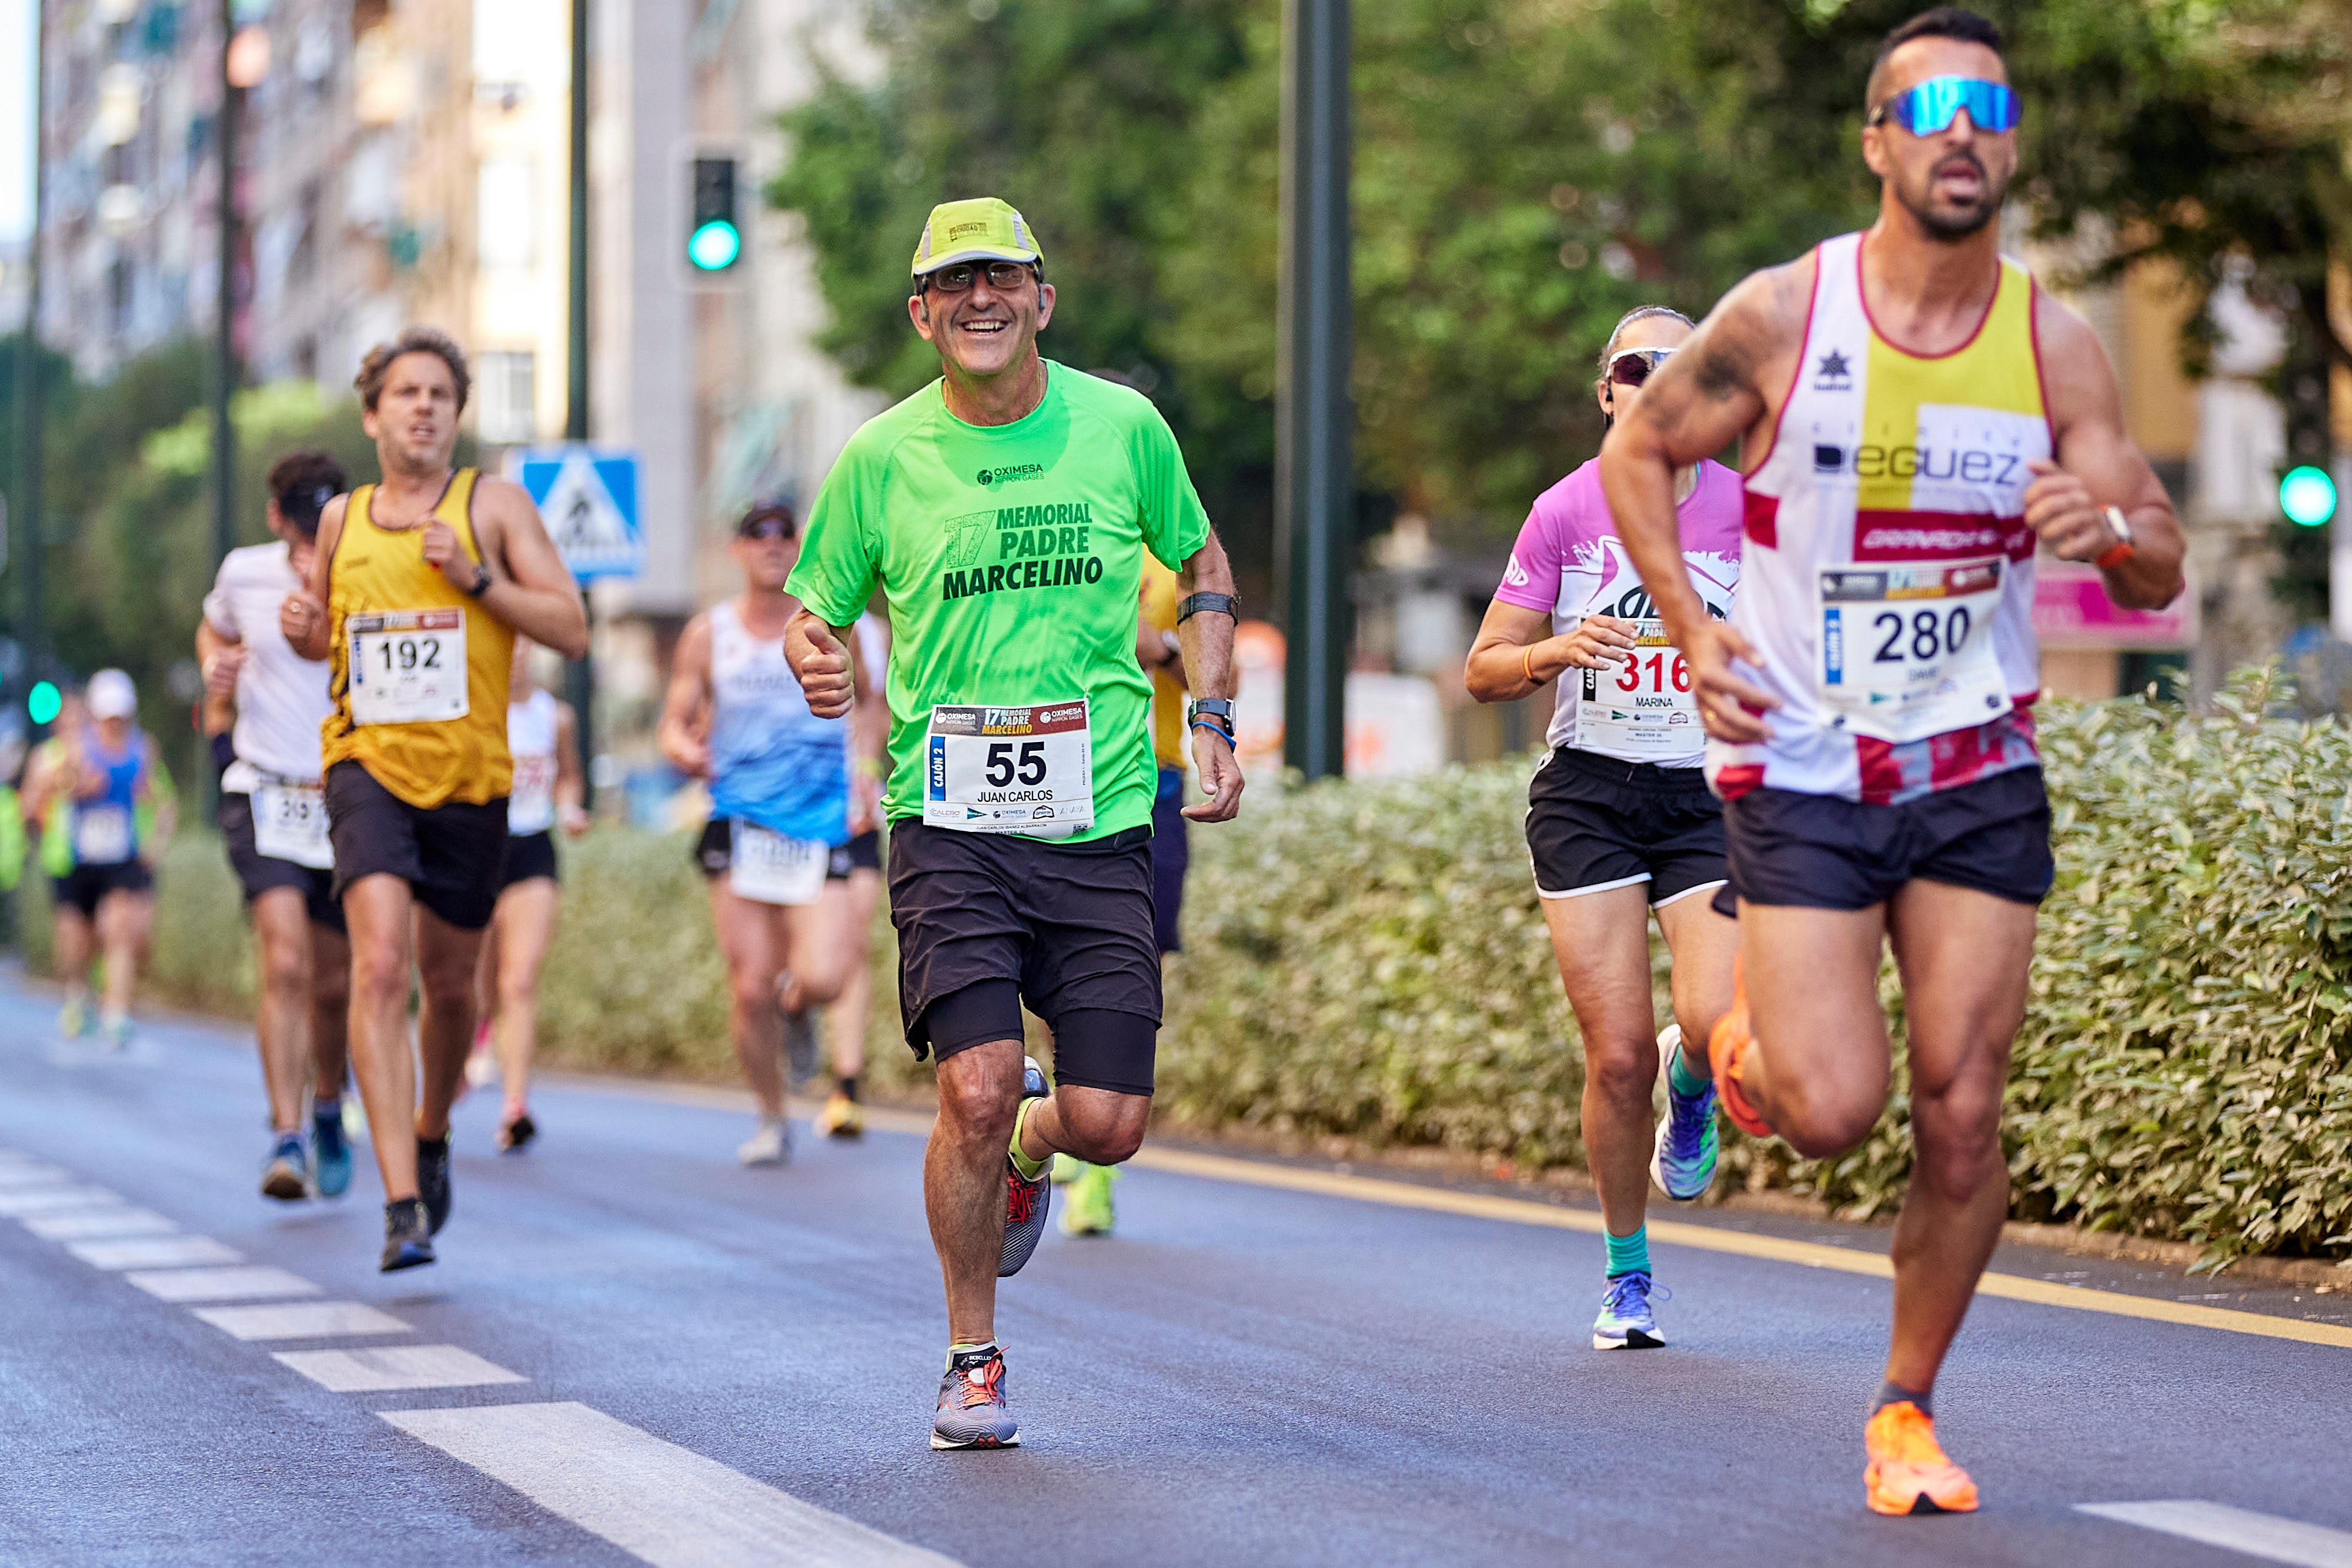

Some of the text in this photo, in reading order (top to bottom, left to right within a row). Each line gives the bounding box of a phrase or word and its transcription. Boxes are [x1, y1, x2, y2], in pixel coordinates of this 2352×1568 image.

[994, 463, 1043, 476] OXIMESA
[995, 475, 1020, 484] NIPPON
[996, 503, 1093, 529] MEMORIAL
[944, 510, 995, 569] 17
[1000, 526, 1089, 560] PADRE
[943, 556, 1102, 600] MARCELINO
[1873, 605, 1970, 663] 280
[379, 638, 441, 670] 192
[1584, 668, 1595, 690] CAJÓ
[1615, 653, 1692, 693] 316
[1000, 708, 1031, 717] MEMORIAL
[1051, 707, 1083, 717] OXIMESA
[1635, 697, 1673, 707] MARINA
[984, 708, 1001, 726] 17
[1000, 716, 1030, 726] PADRE
[982, 724, 1033, 734] MARCELINO
[933, 761, 944, 787] CAJÓN
[985, 741, 1047, 787] 55
[977, 790, 1053, 803] JUAN CARLOS
